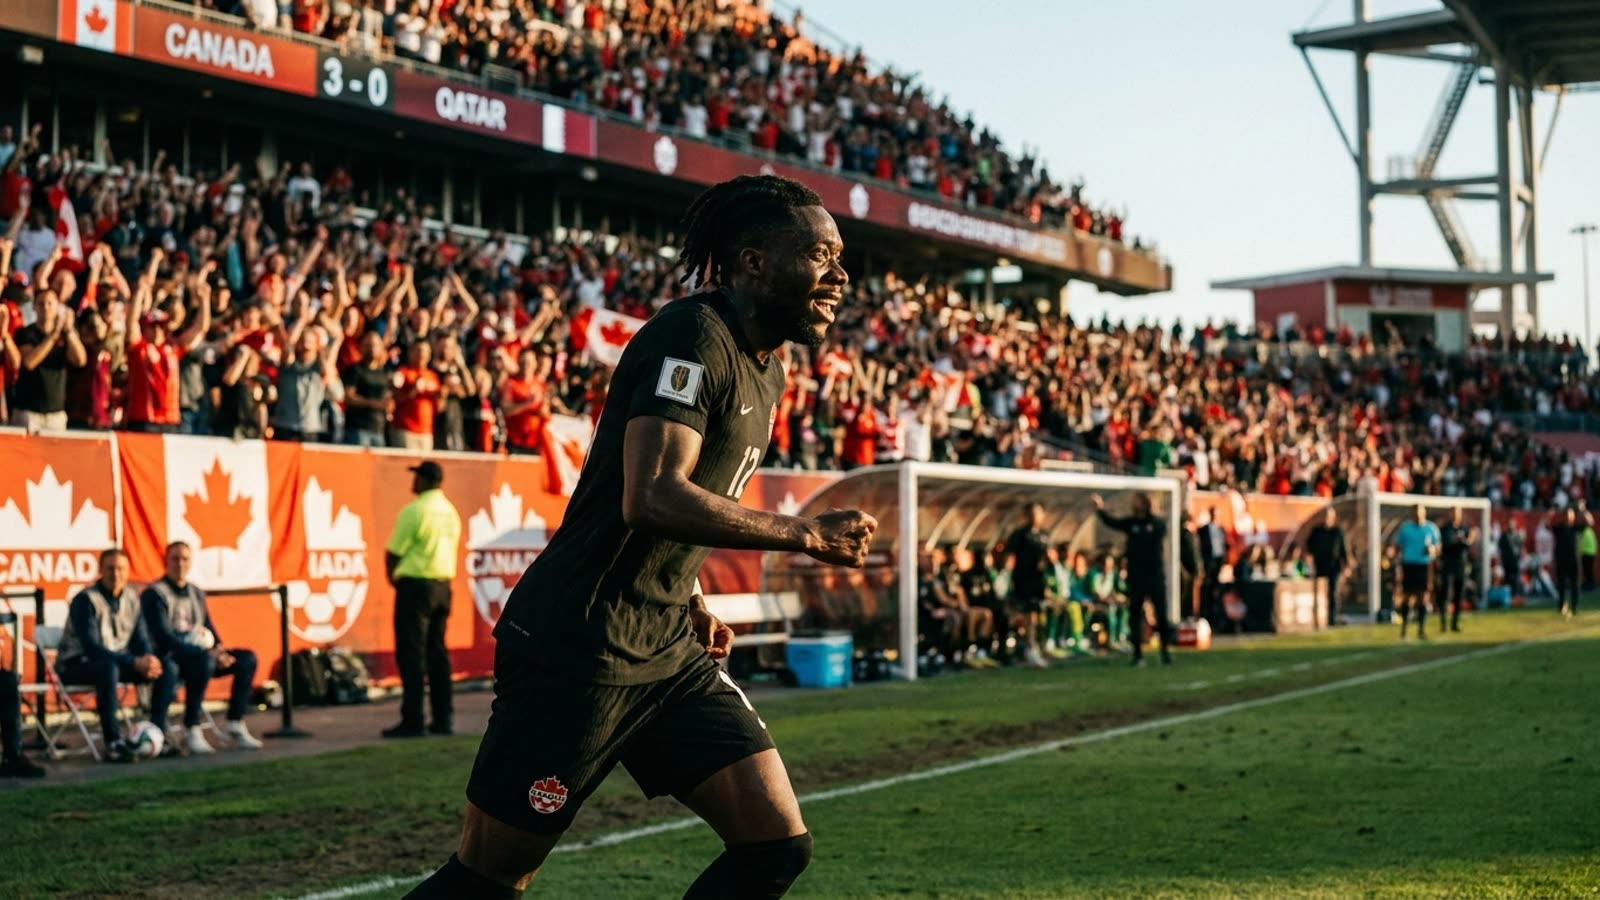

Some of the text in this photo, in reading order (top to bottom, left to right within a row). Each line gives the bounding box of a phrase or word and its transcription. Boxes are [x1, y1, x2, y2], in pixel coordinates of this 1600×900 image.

[164, 22, 275, 79] CANADA
[323, 56, 344, 97] 3
[367, 67, 388, 107] 0
[435, 86, 507, 131] QATAR
[0, 552, 99, 583] ANAD
